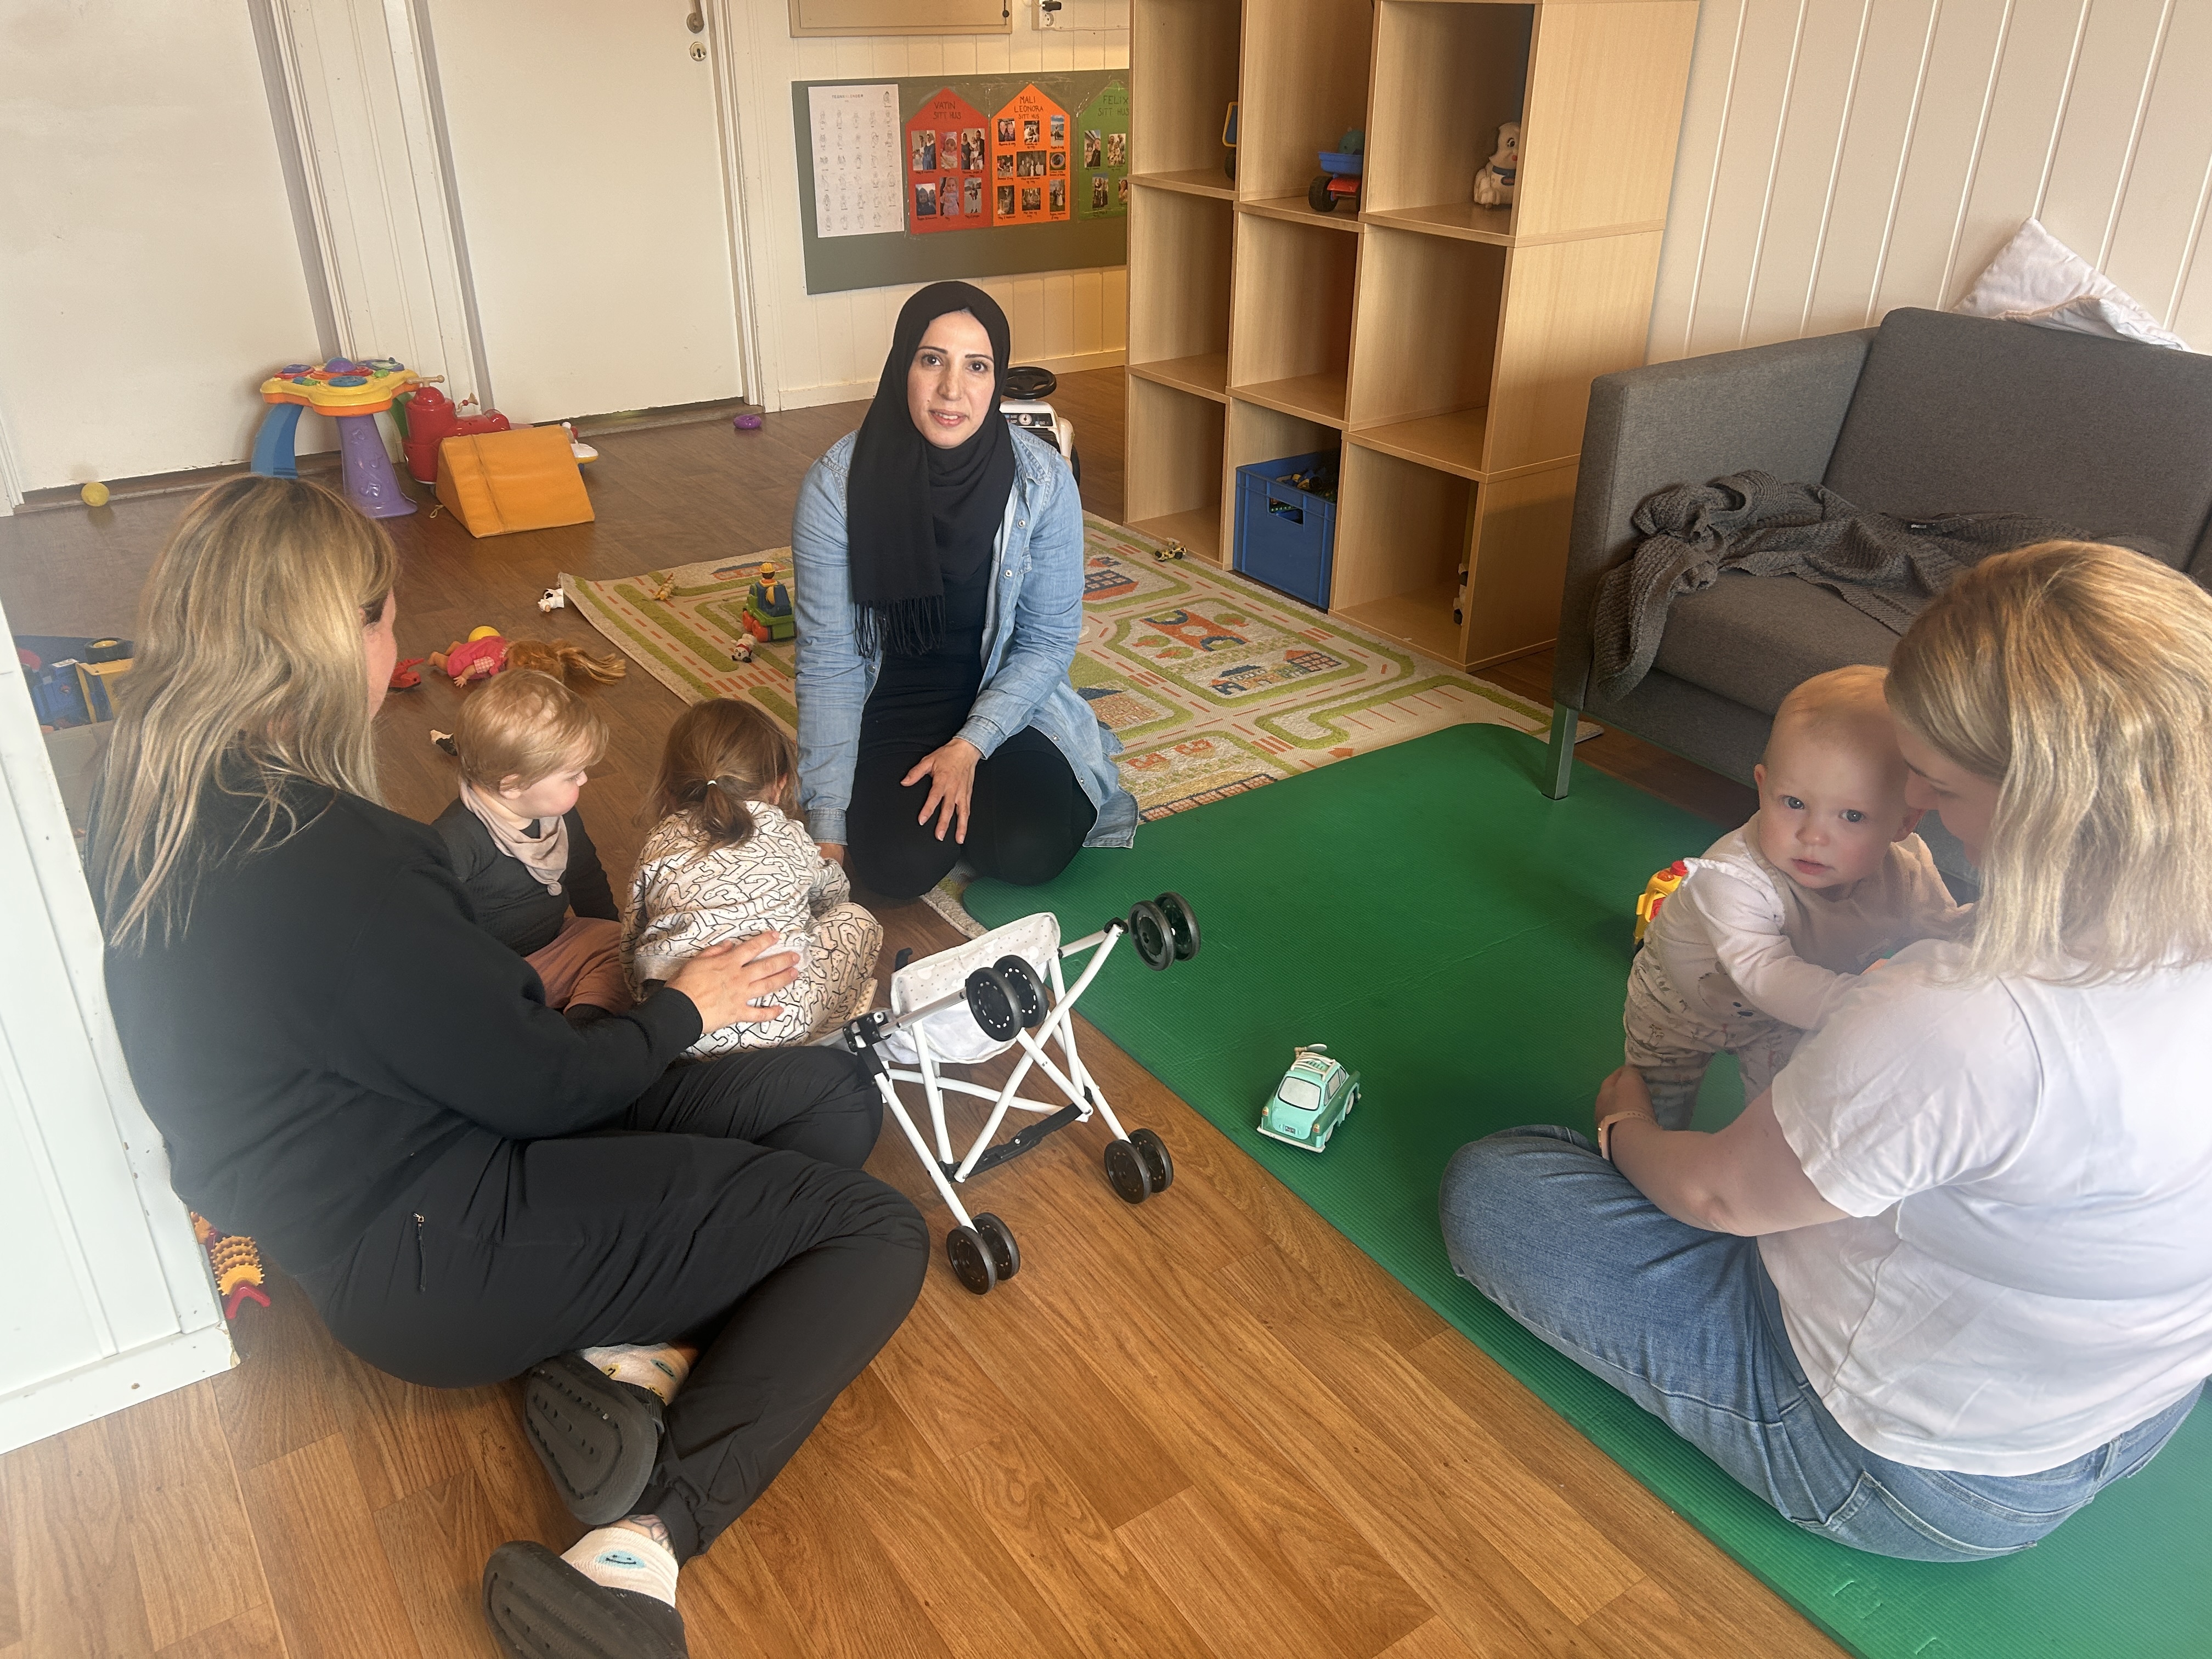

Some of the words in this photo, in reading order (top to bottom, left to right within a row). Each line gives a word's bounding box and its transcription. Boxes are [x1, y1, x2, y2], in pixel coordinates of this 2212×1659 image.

[1019, 95, 1036, 104] MALI
[1103, 95, 1128, 105] FELIX
[1014, 105, 1044, 113] LEONORA
[1098, 107, 1113, 116] SITT
[1117, 108, 1129, 116] HUS
[933, 111, 947, 120] SITT
[949, 111, 962, 120] HUS
